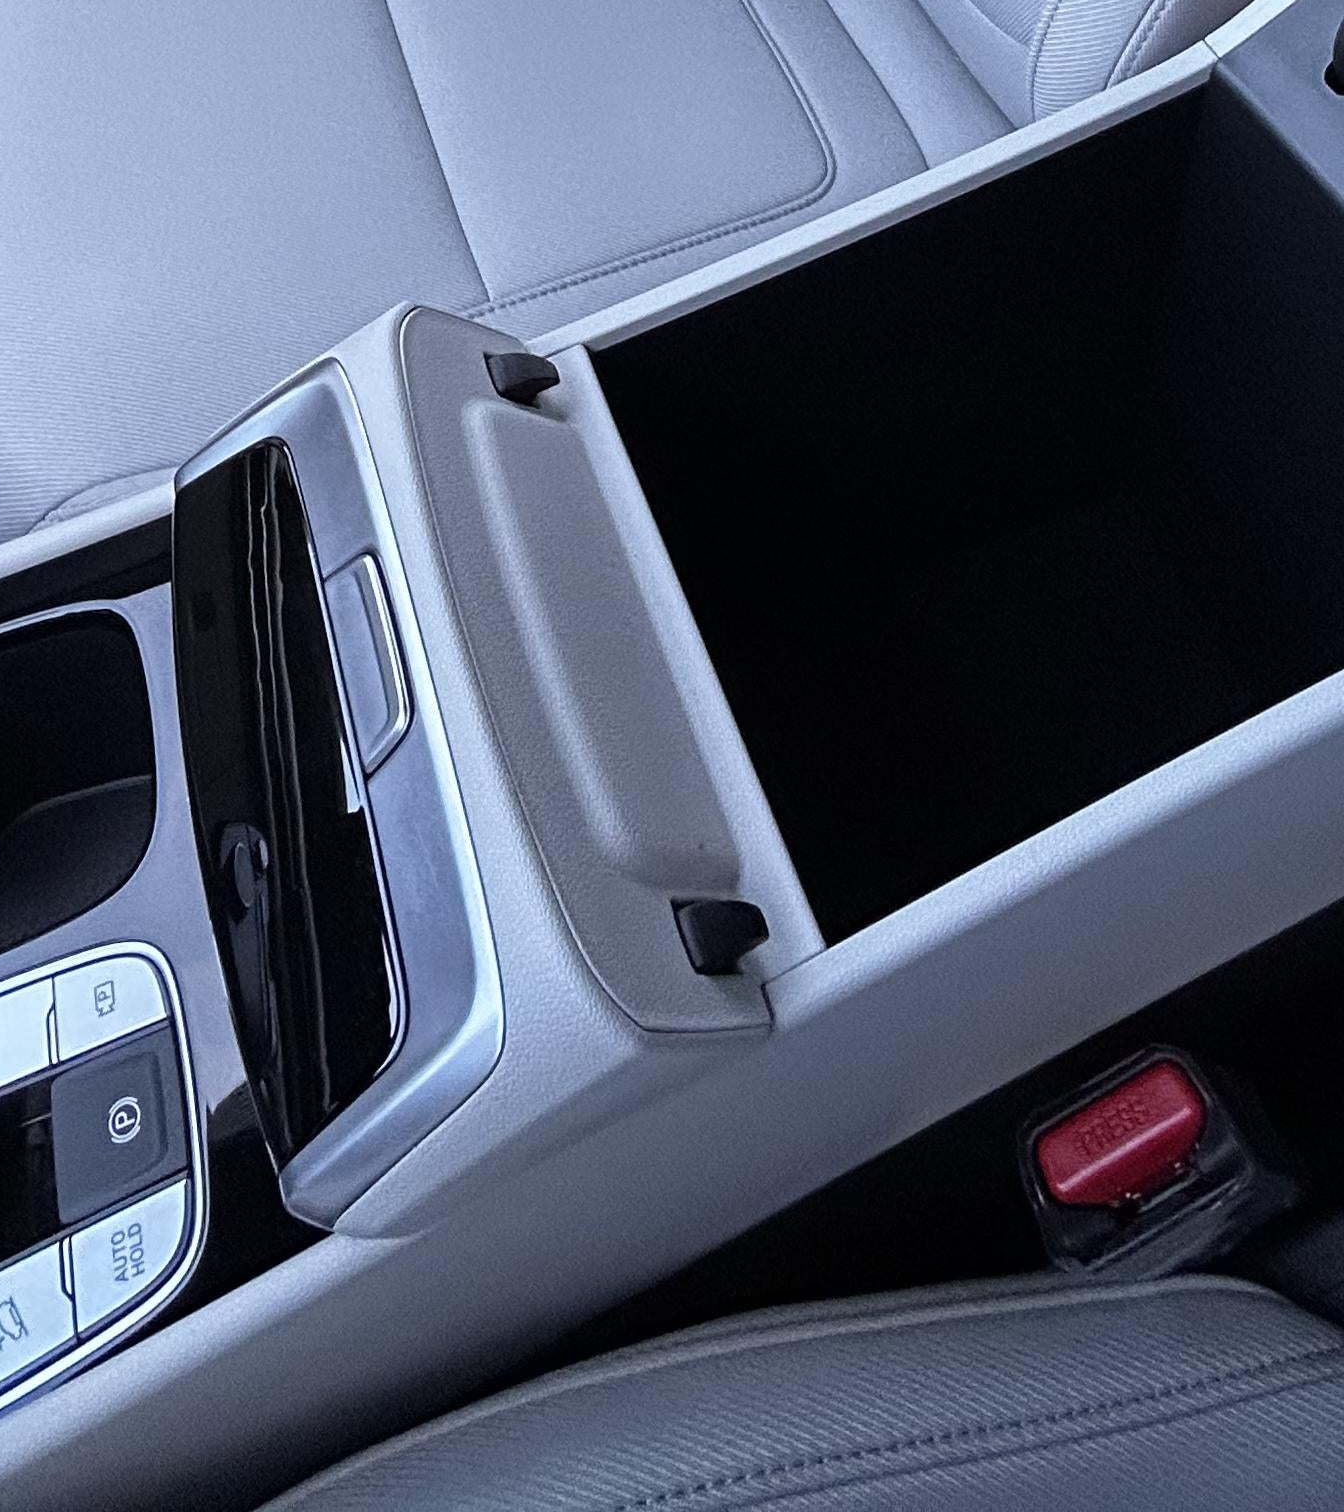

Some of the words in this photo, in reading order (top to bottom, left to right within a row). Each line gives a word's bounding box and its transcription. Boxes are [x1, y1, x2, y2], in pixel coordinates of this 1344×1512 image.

[1078, 1101, 1149, 1156] PRESS
[111, 1230, 129, 1282] AUTO
[127, 1222, 146, 1277] HOLD
